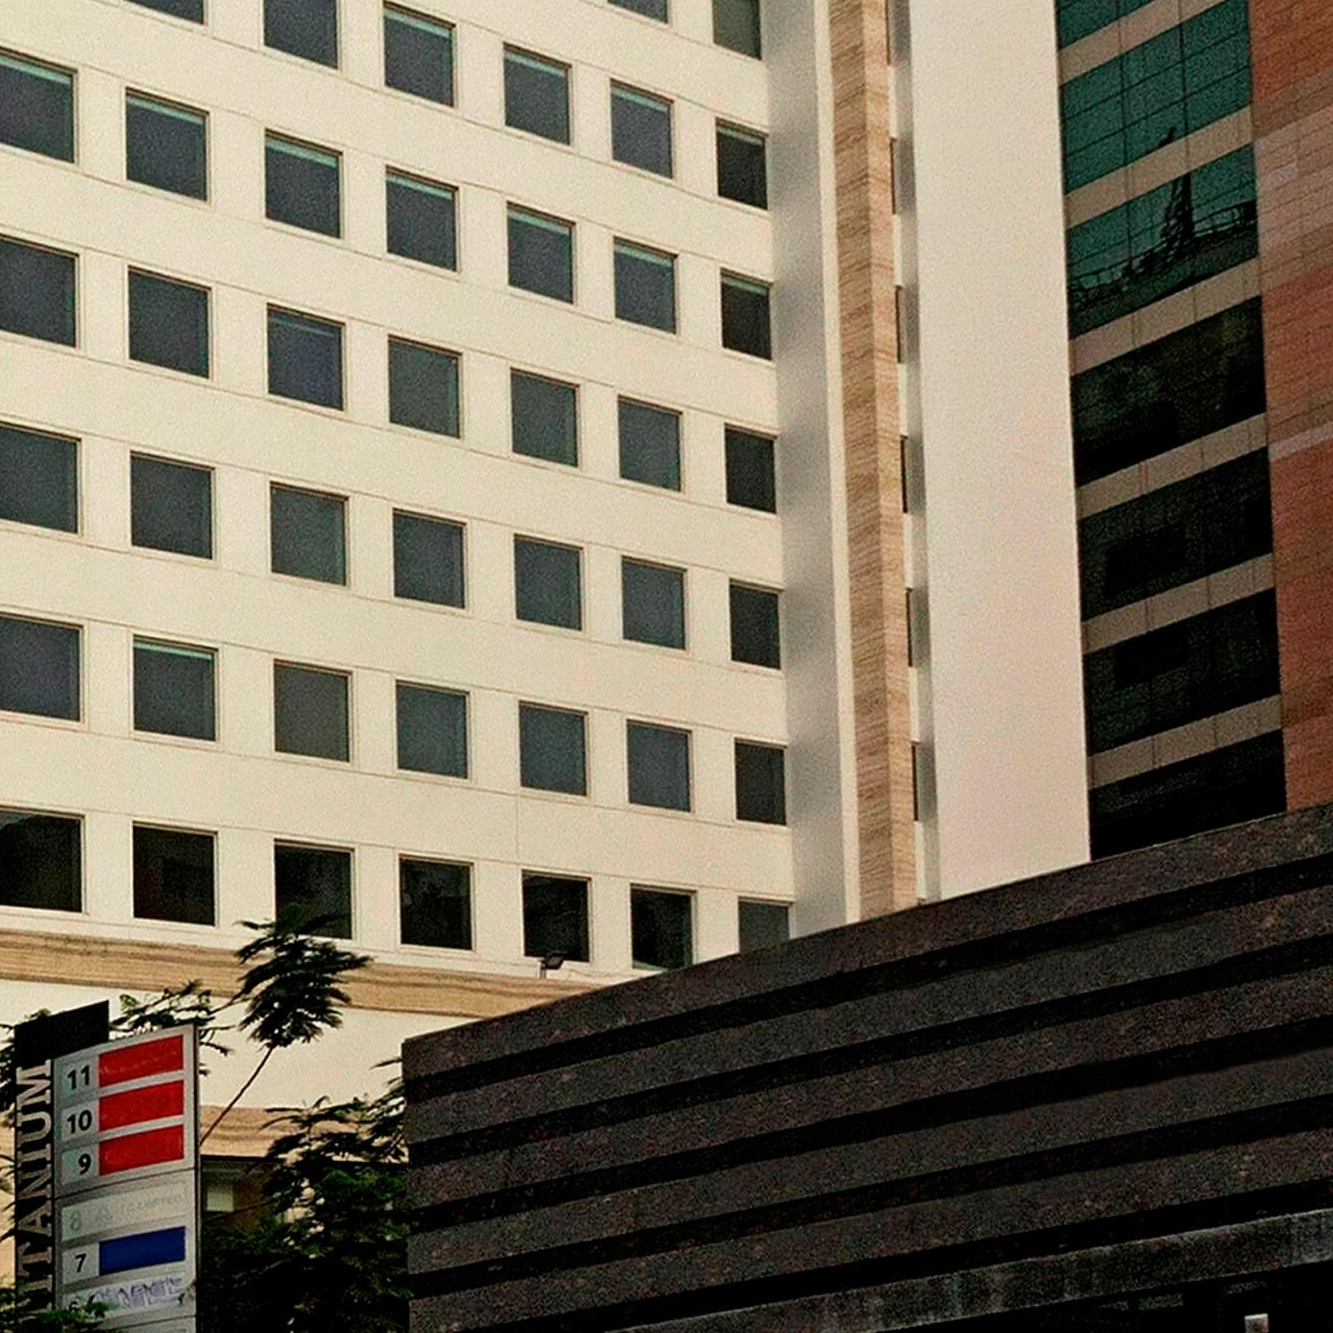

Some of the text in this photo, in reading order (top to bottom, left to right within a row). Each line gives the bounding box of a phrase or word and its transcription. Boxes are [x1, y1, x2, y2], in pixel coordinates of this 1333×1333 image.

[67, 1065, 90, 1090] 11
[67, 1109, 93, 1135] 10
[78, 1153, 91, 1175] 9
[75, 1253, 87, 1273] 7
